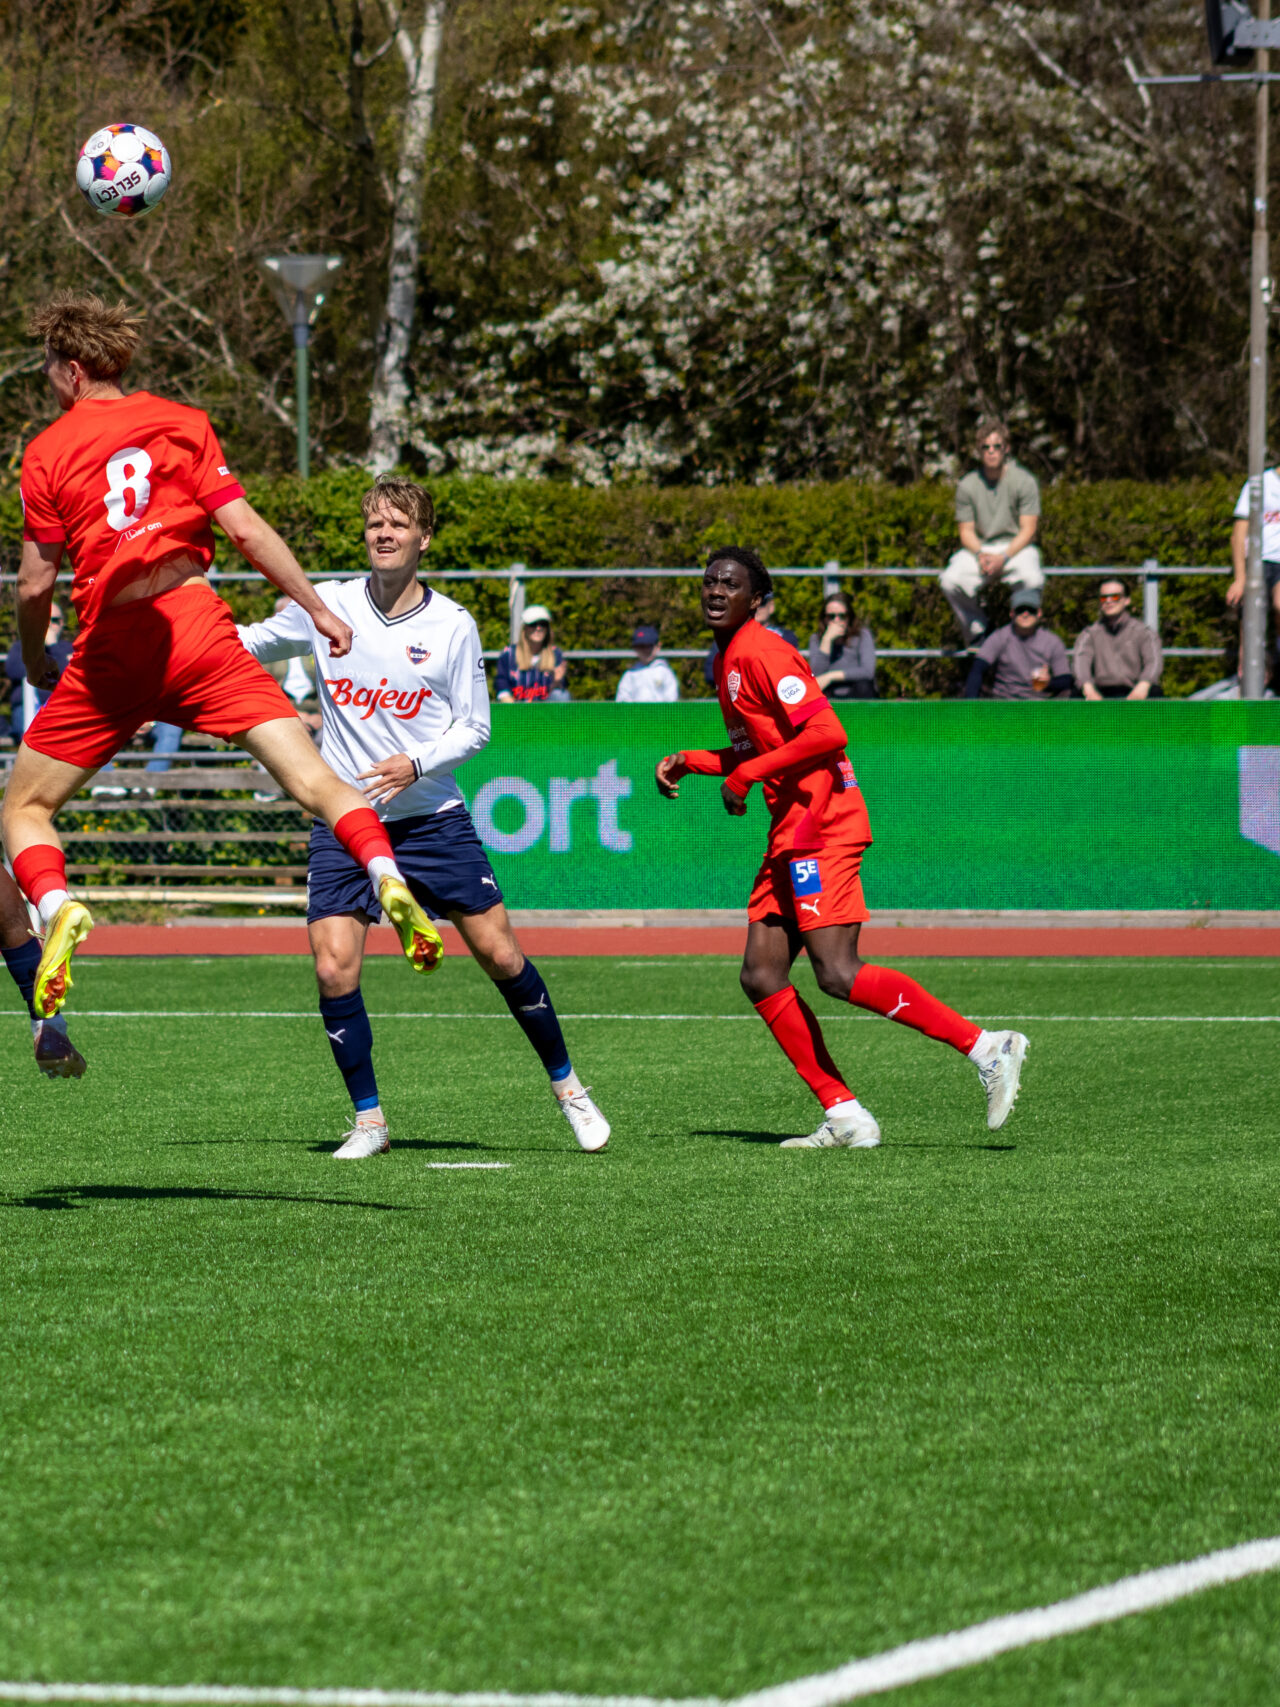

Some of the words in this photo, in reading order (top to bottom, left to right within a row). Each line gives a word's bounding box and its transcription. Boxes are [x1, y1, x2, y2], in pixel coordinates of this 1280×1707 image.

[96, 171, 142, 203] SELECT
[103, 447, 152, 532] 8
[324, 677, 433, 721] Bajeur
[468, 758, 633, 853] ort
[795, 861, 817, 883] 5E
